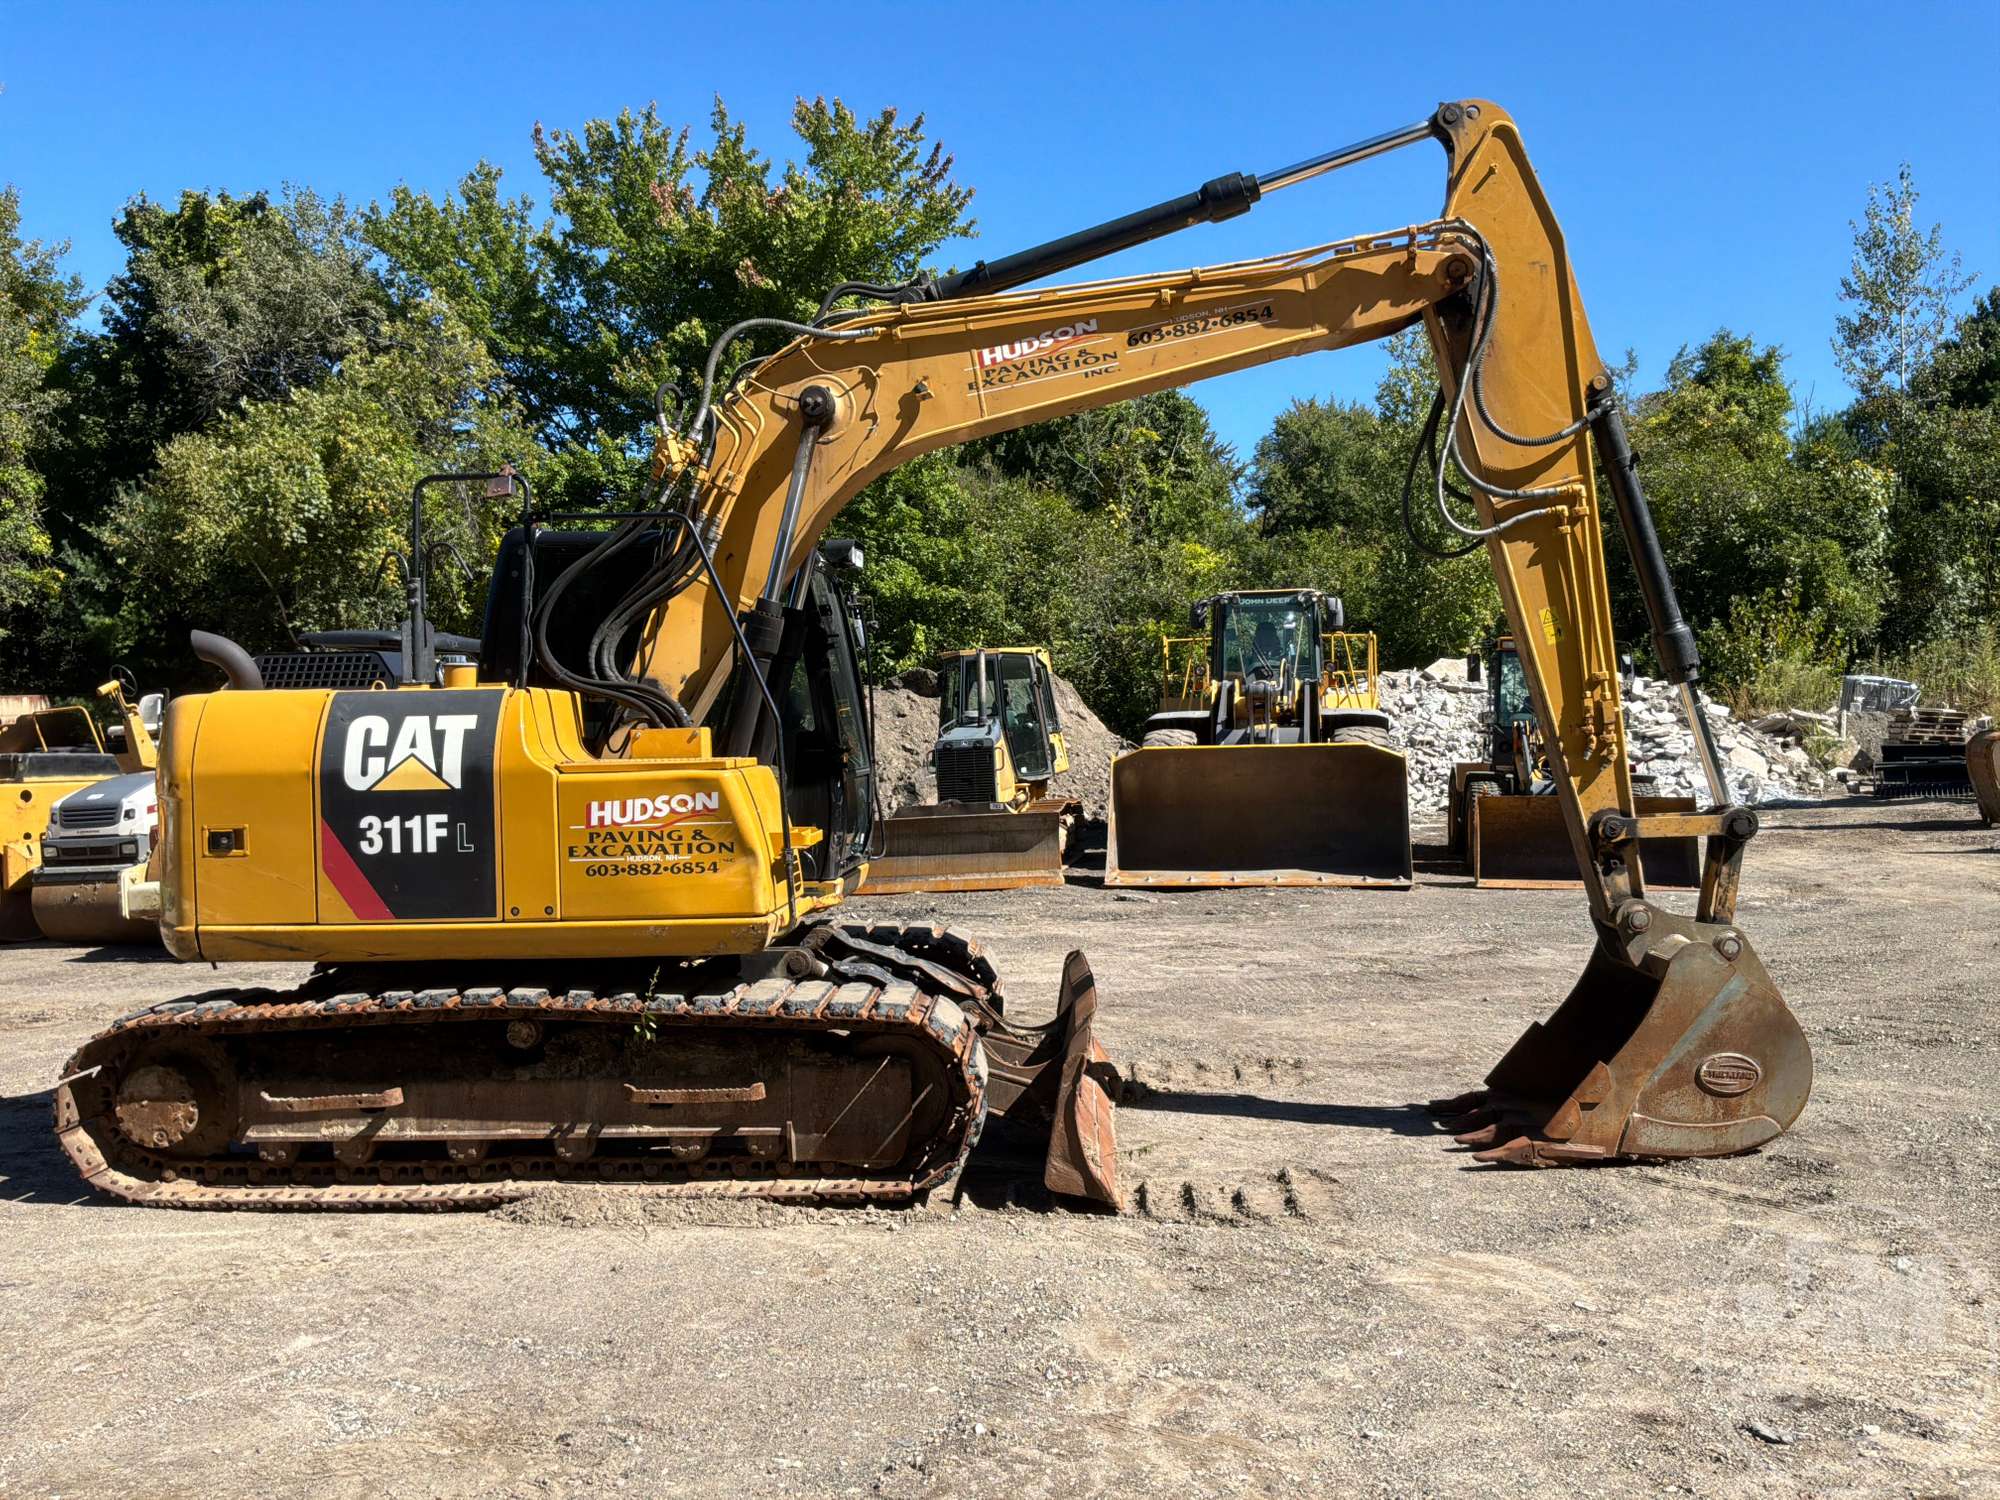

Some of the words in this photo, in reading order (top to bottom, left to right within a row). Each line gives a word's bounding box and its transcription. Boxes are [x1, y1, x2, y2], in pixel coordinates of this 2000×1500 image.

[981, 318, 1098, 367] HUDSON
[967, 351, 1118, 391] EXCAVATION
[984, 352, 1070, 378] PAVING
[1077, 348, 1095, 358] &
[1083, 365, 1121, 379] INC.
[344, 715, 478, 791] CAT
[586, 791, 719, 828] HUDSON
[359, 814, 449, 855] 311F
[457, 822, 475, 853] L
[567, 842, 735, 858] EXCAVATION
[588, 830, 684, 843] PAVING
[692, 829, 711, 841] &
